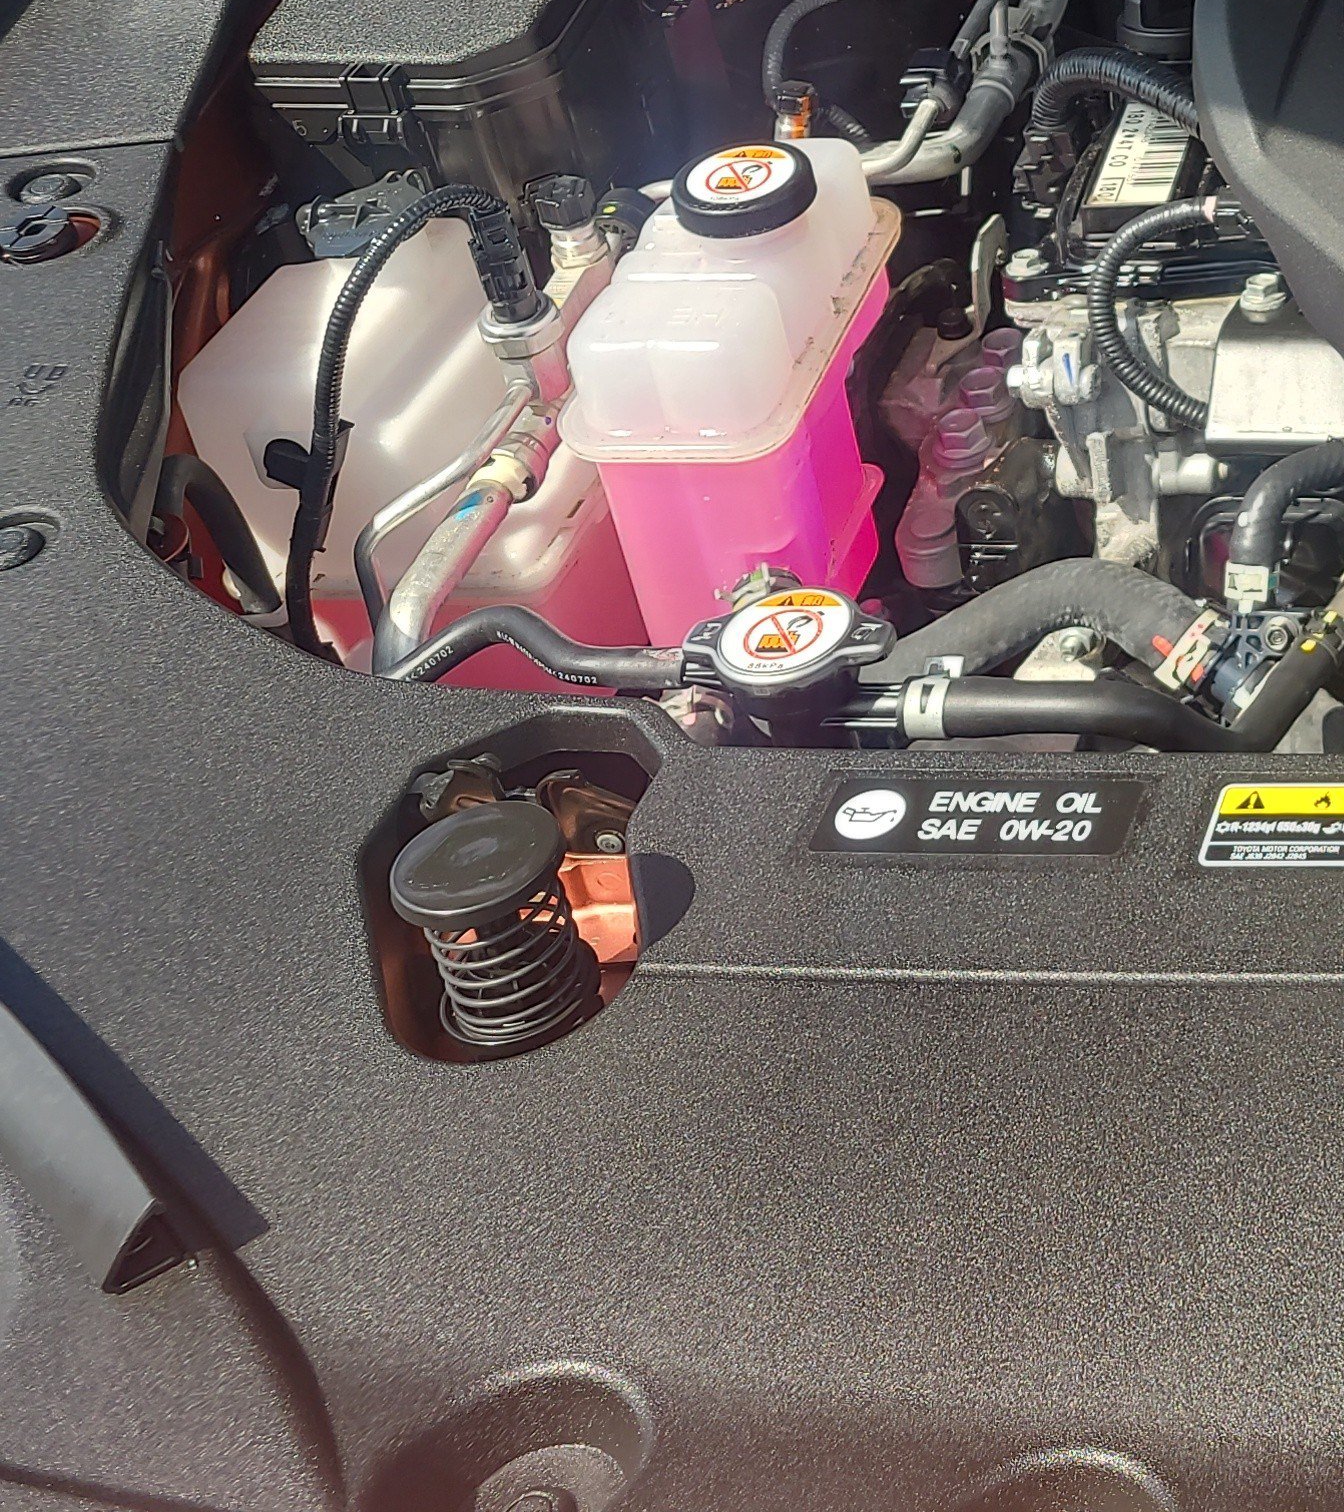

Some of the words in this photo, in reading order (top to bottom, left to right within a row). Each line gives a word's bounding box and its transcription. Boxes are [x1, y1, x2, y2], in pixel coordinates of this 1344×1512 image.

[928, 791, 1042, 813] ENGINE
[1055, 791, 1103, 814] OIL
[917, 818, 983, 841] SAE
[998, 819, 1092, 842] 0W-20
[1229, 853, 1245, 861] SAE
[1232, 845, 1261, 854] TOYOTA
[1261, 845, 1289, 854] MOTOR
[1289, 845, 1341, 855] CORPORATION
